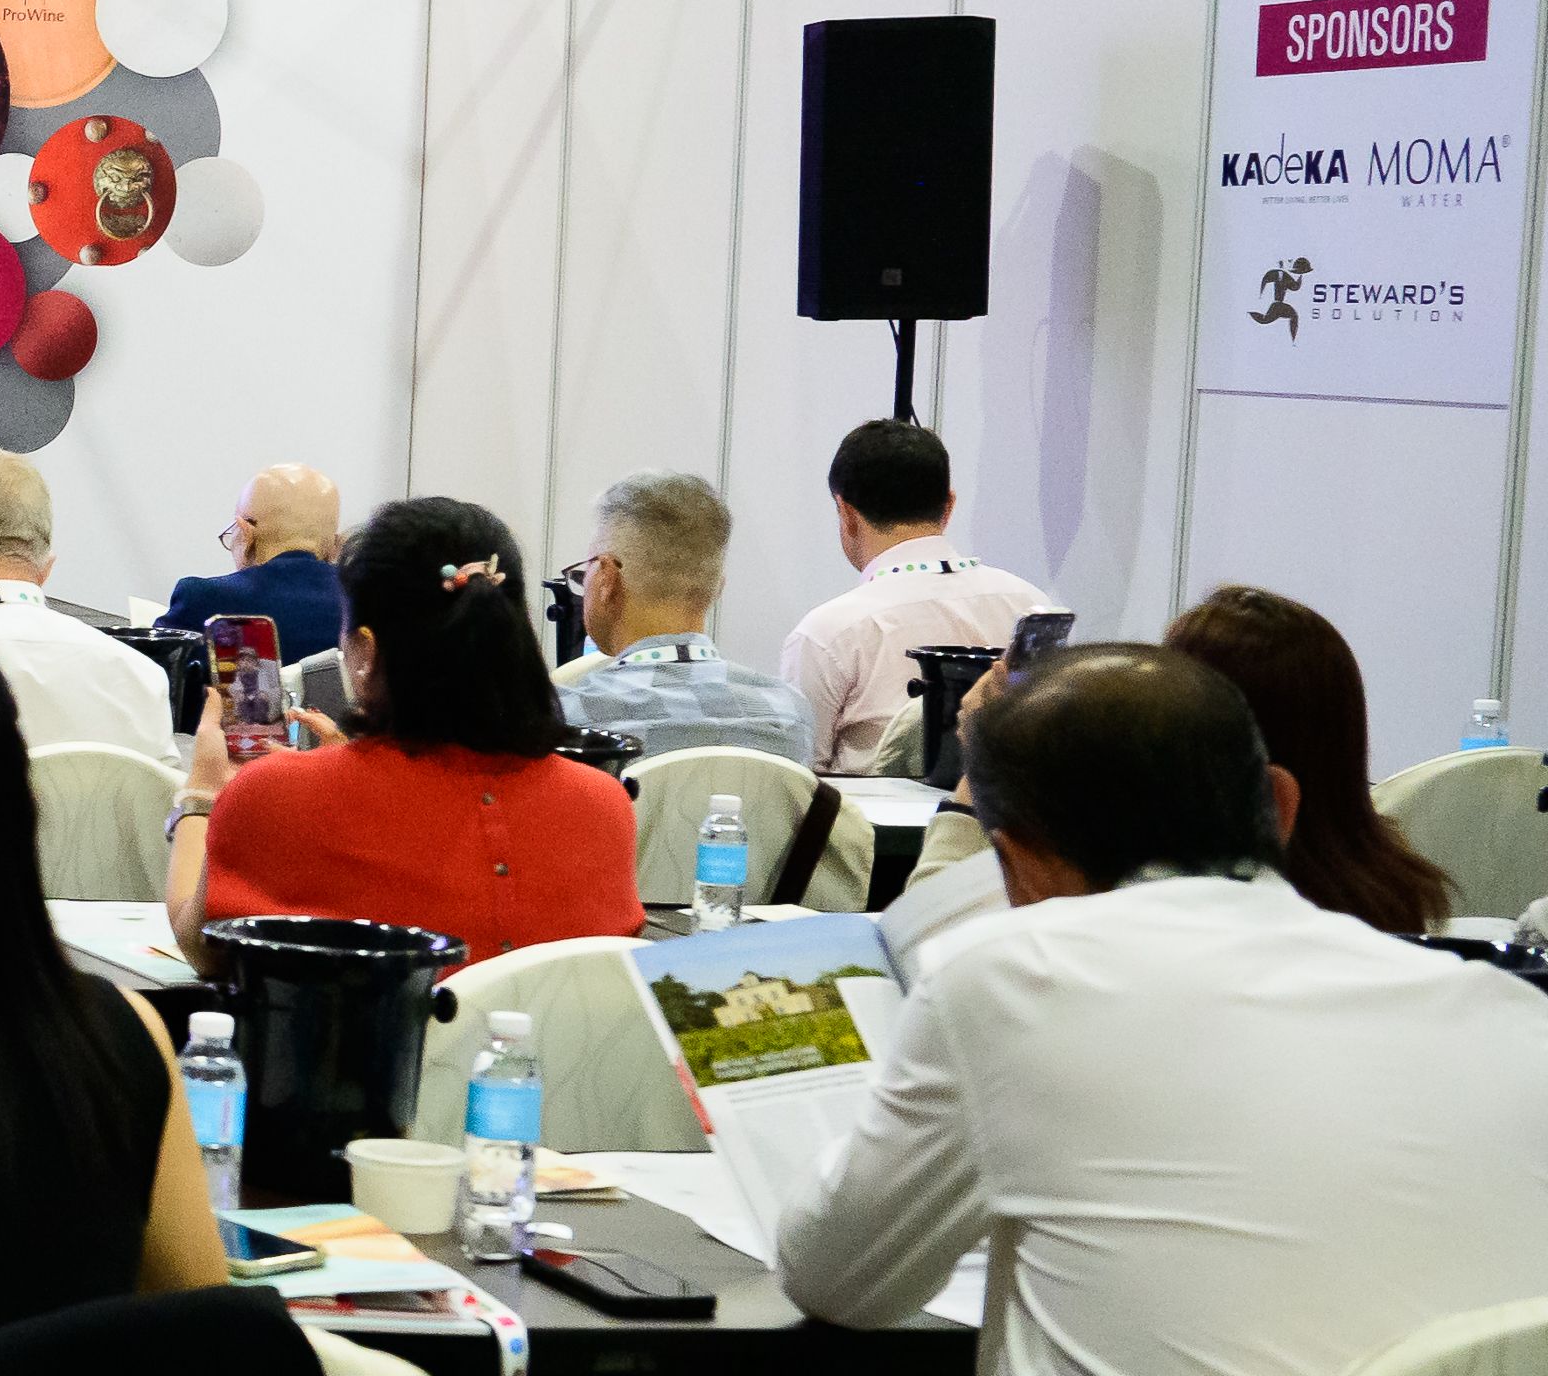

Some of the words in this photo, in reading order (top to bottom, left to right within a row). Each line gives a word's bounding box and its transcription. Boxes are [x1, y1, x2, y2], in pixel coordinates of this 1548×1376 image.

[2, 8, 65, 22] ProWine
[1286, 0, 1456, 63] SPONSORS
[1221, 133, 1349, 187] KAdeKA
[1402, 193, 1463, 207] WATER
[1312, 281, 1464, 305] STEWARD'S
[1312, 308, 1463, 323] SOLUTION
